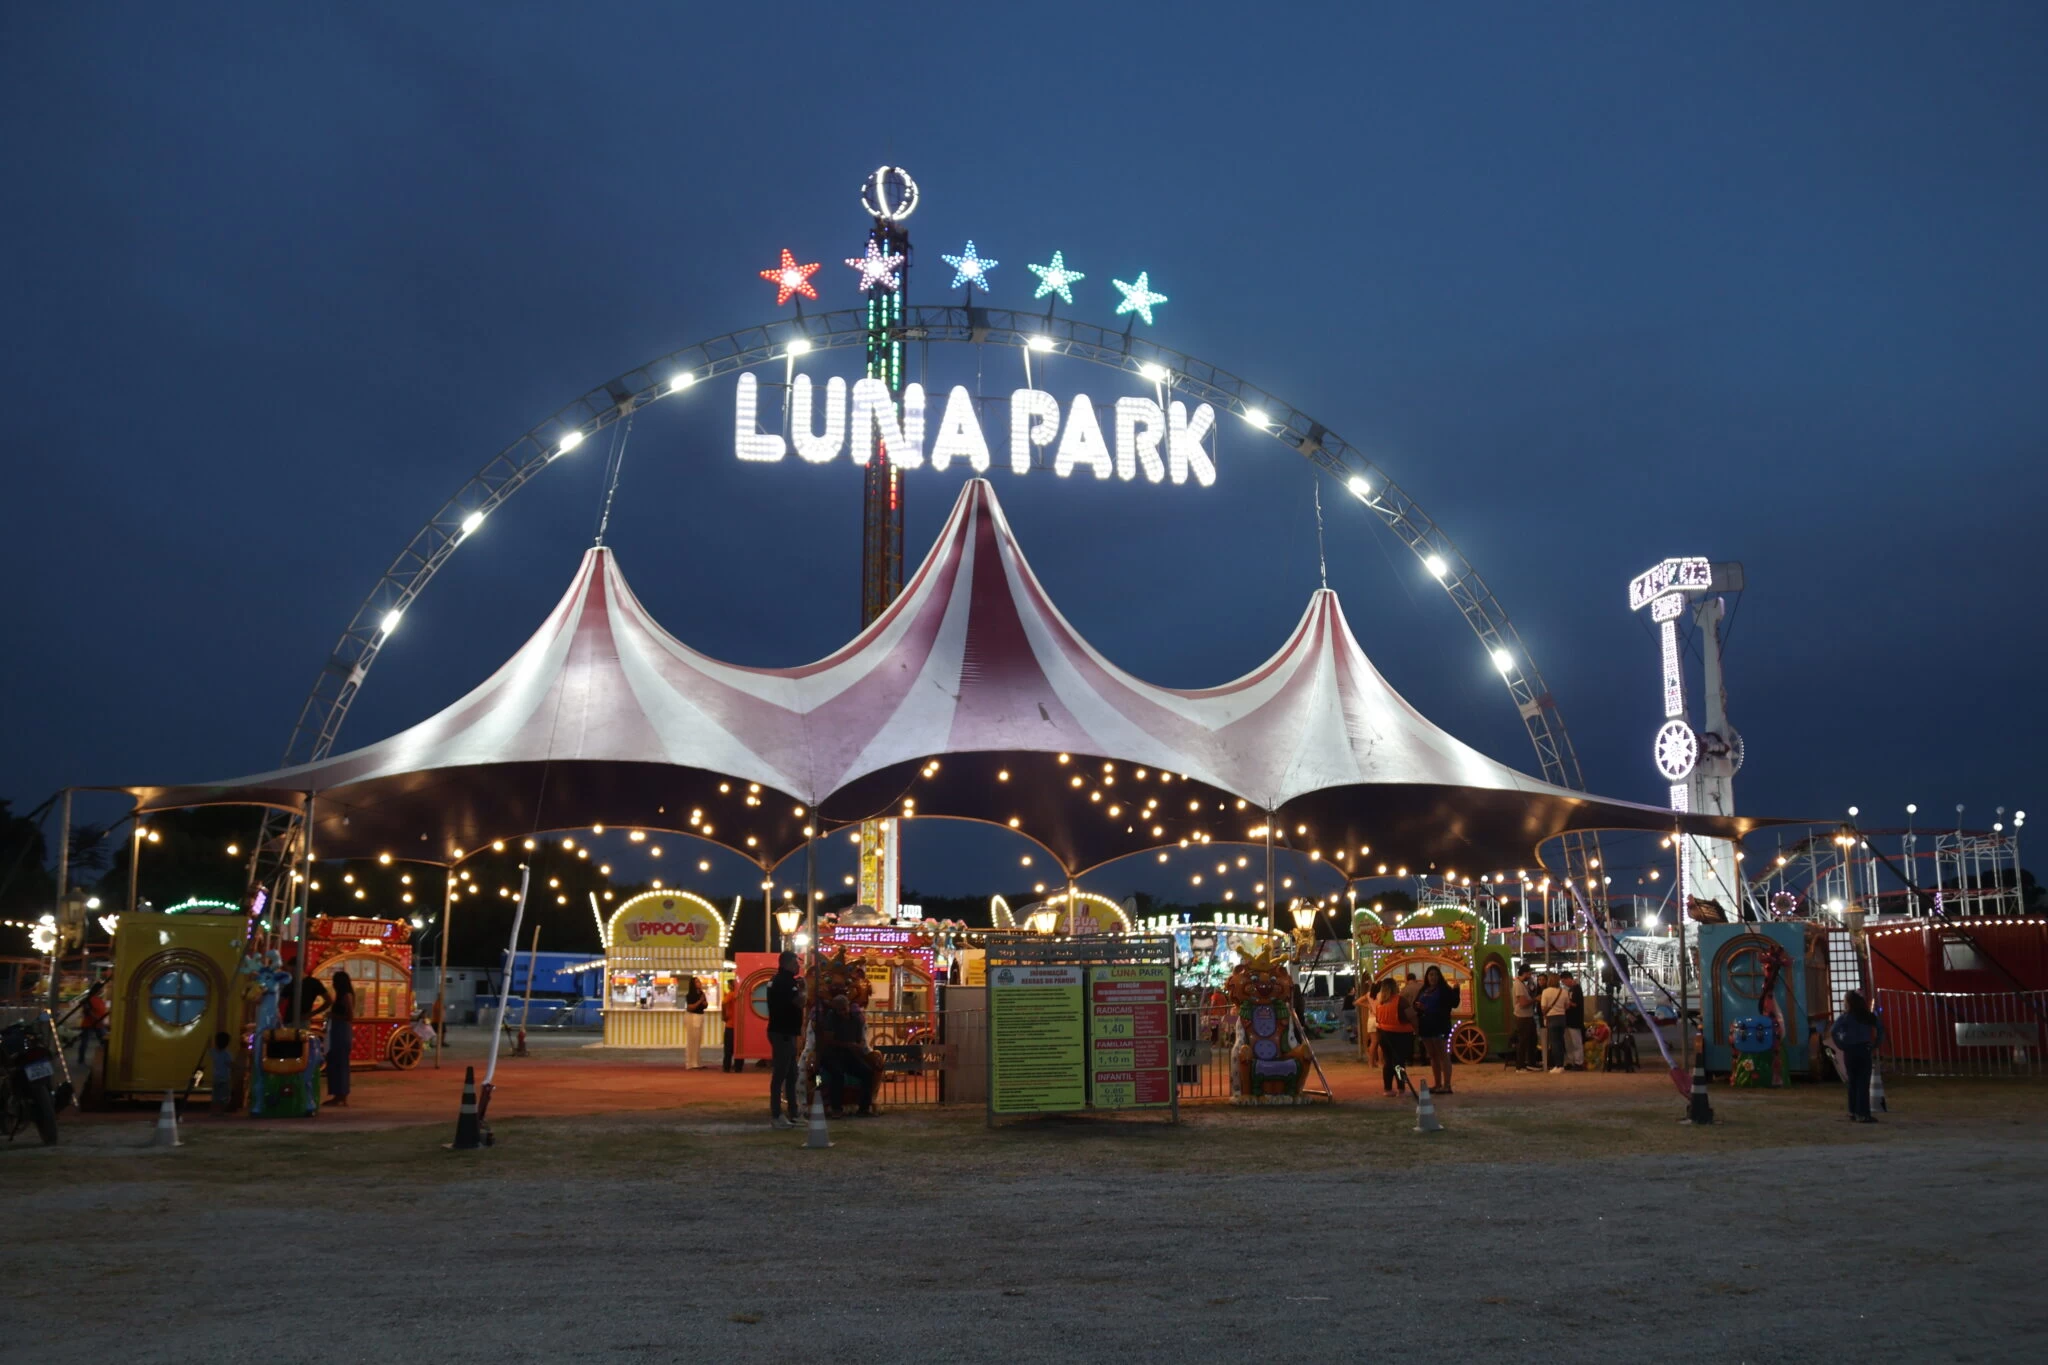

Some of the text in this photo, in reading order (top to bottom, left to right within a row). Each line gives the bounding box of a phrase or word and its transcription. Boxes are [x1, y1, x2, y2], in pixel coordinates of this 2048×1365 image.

[735, 371, 1216, 487] LUNA PARK
[638, 921, 696, 936] PIPOCA
[1111, 968, 1164, 977] LUNA PARK
[1096, 1006, 1133, 1014] RADICAIS
[1096, 1040, 1134, 1048] FAMILIAR
[1097, 1072, 1134, 1081] INFANTIL
